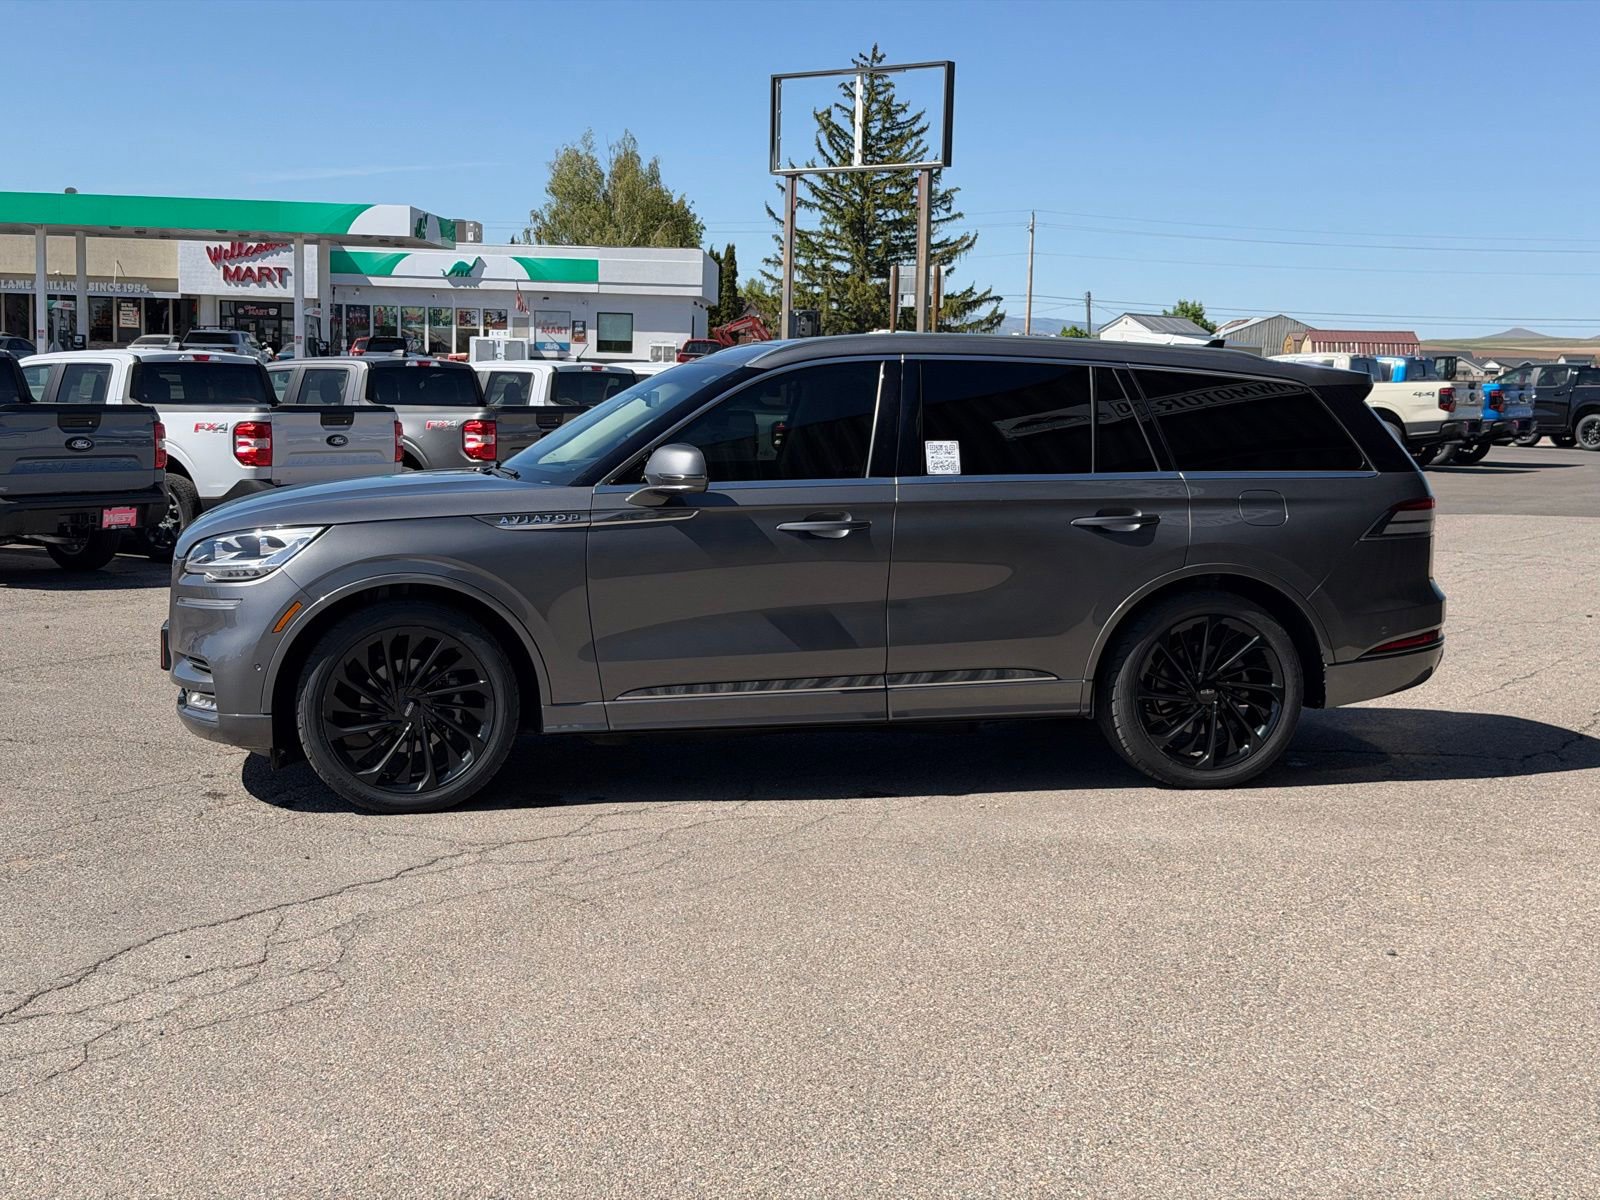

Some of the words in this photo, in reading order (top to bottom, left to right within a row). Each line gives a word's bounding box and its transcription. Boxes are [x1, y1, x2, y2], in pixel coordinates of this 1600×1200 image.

[223, 265, 290, 286] MART
[34, 280, 77, 291] ILLIN
[88, 282, 120, 292] SINCE
[122, 283, 149, 293] 1954
[541, 326, 569, 335] MART
[194, 422, 228, 433] FX4
[425, 420, 459, 431] FX4
